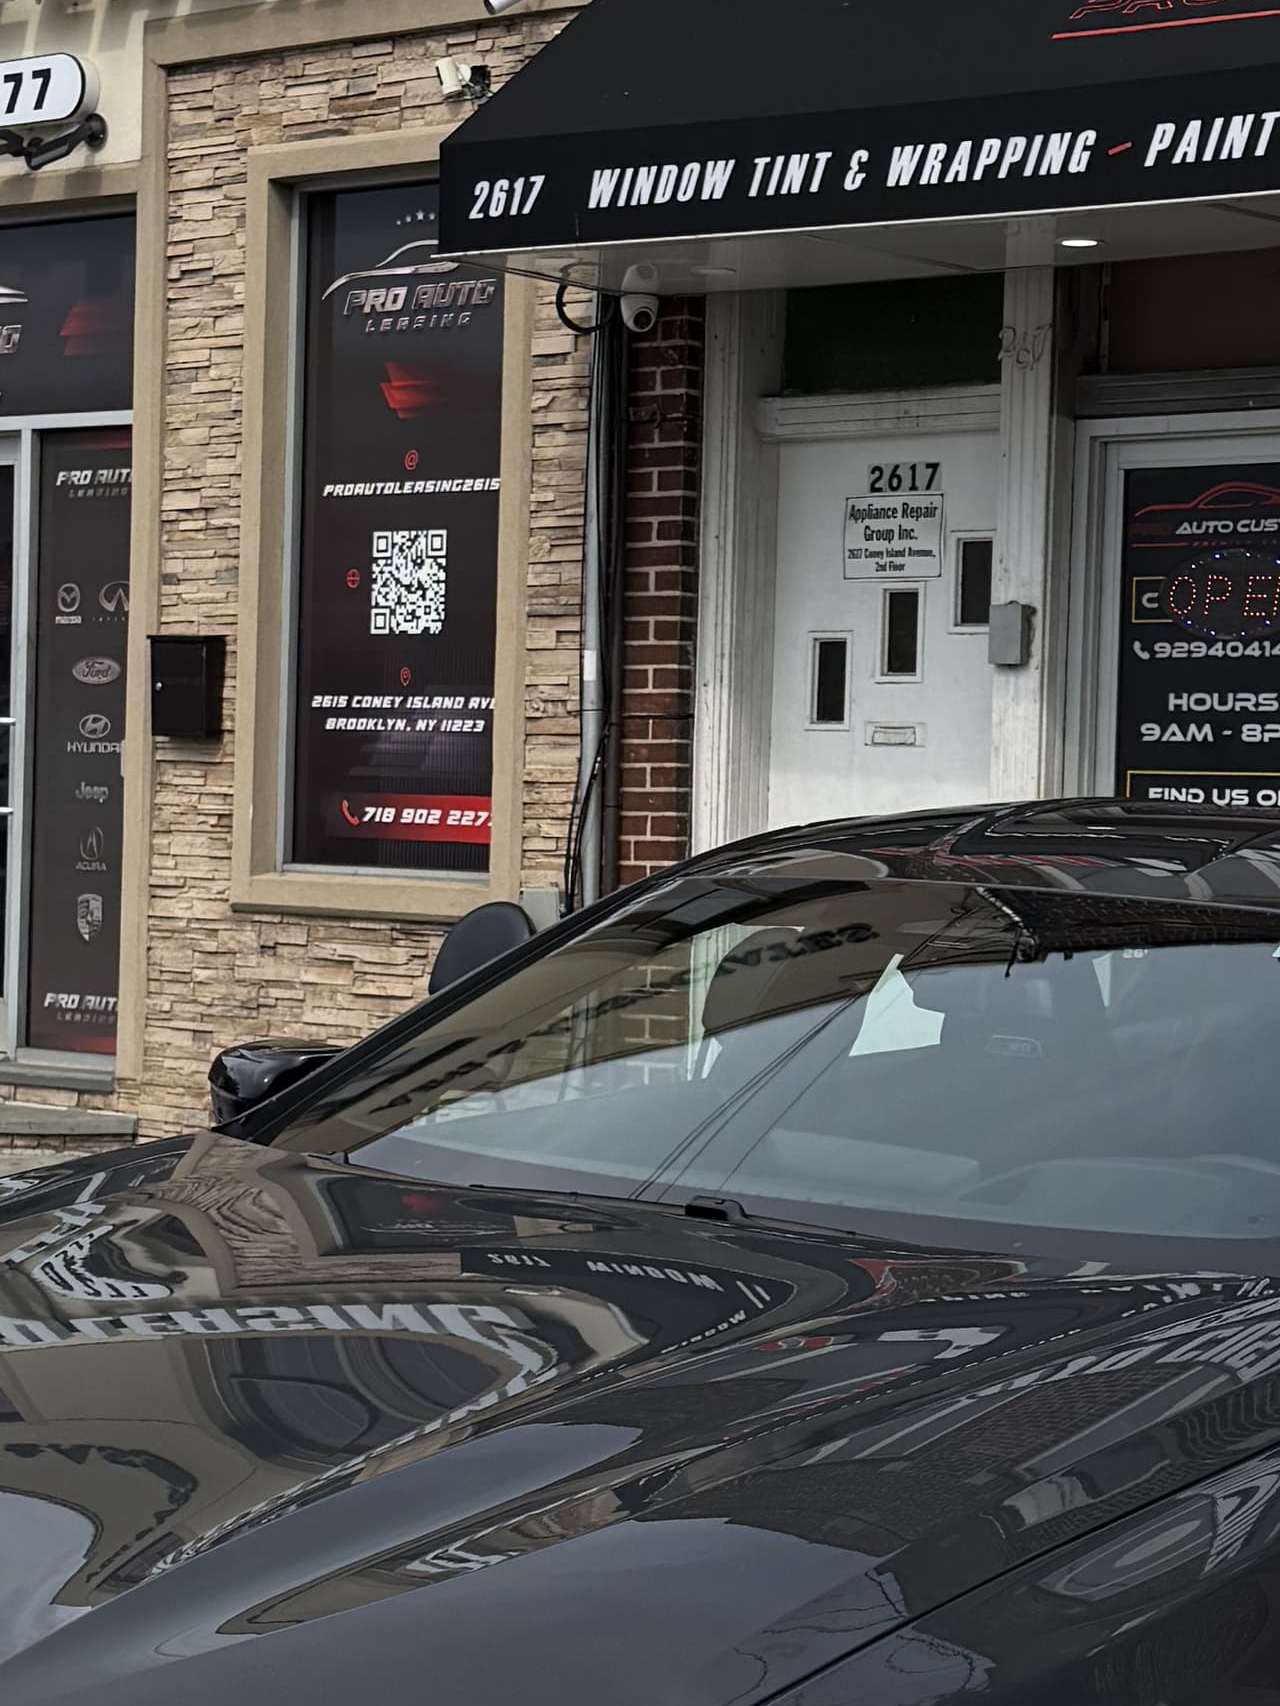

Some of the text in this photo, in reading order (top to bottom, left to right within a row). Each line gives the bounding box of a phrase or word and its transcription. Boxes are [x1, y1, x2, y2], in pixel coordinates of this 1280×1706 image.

[470, 174, 546, 219] 2617
[587, 145, 731, 211] WINDOW
[749, 144, 830, 199] TINT
[844, 151, 870, 189] &
[886, 129, 1097, 187] WRAPPING
[343, 279, 497, 316] PRO AUTO
[365, 311, 472, 333] LEASING
[56, 470, 93, 486] PRO
[870, 462, 940, 493] 2617
[322, 478, 501, 497] PROAUTOLEASING2615
[849, 501, 939, 524] Appliance Repair
[864, 525, 895, 544] Group
[1176, 520, 1234, 534] AUTO
[312, 696, 349, 708] 2615
[351, 696, 403, 708] CONEY
[406, 696, 465, 709] ISLAND
[416, 719, 435, 731] NY
[440, 719, 485, 732] 11223
[1140, 723, 1214, 742] 9AM
[67, 741, 122, 754] HYUNDA
[75, 781, 109, 803] Jeep
[1148, 787, 1205, 803] FIND
[1212, 789, 1249, 806] US
[362, 807, 492, 827] 718 902 227
[44, 992, 118, 1011] PRO AUT
